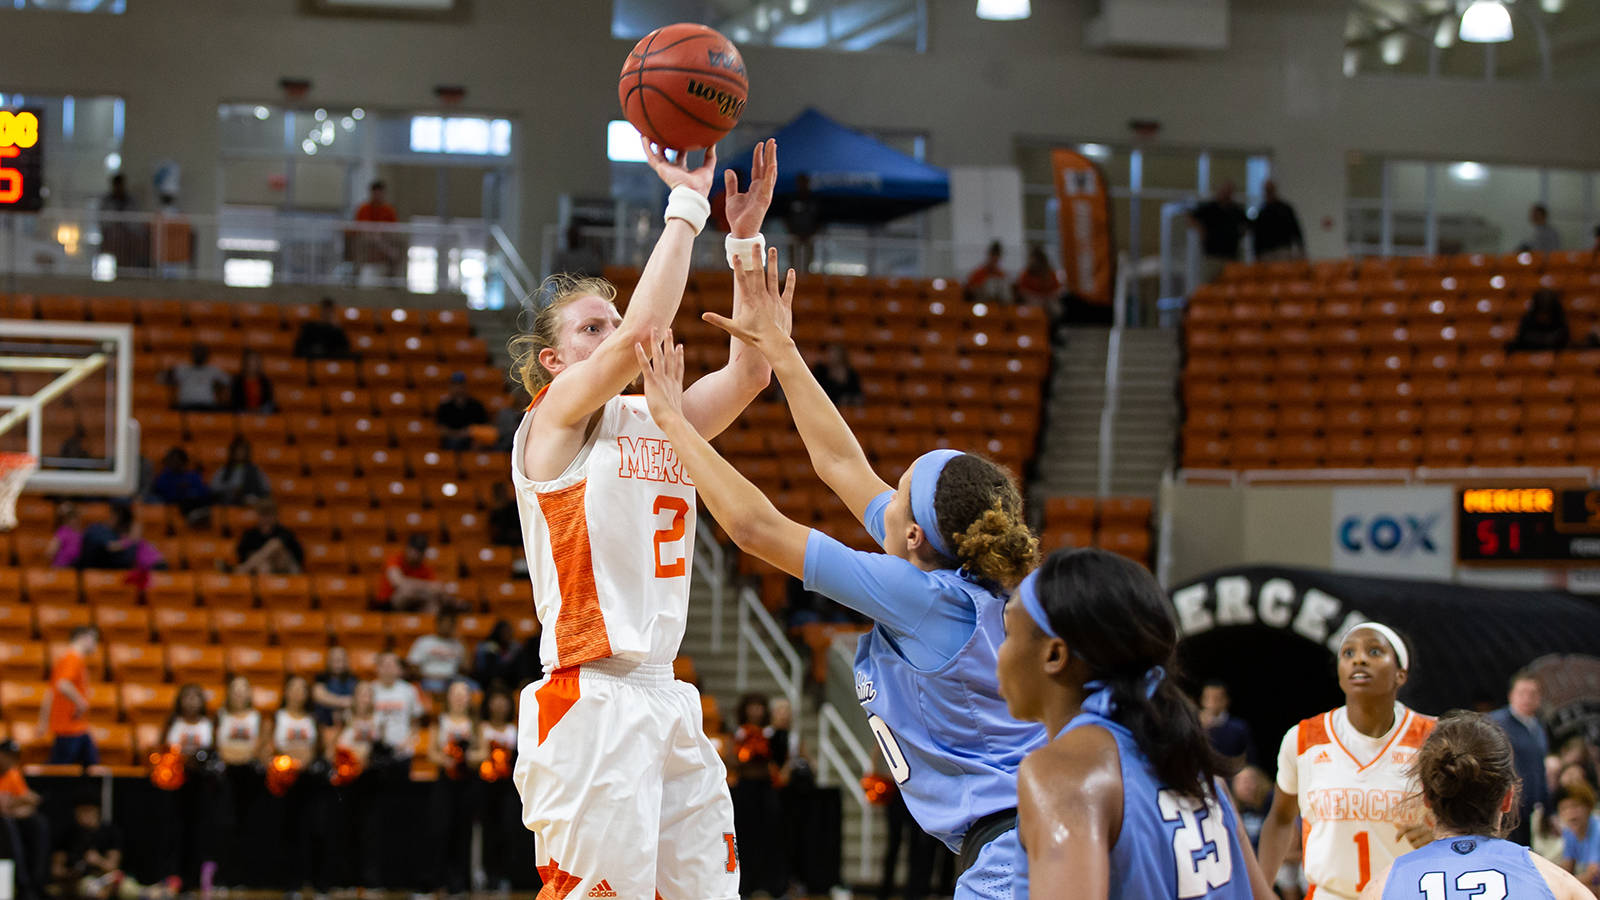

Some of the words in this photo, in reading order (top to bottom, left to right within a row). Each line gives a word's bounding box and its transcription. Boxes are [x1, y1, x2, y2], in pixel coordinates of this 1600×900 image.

[653, 495, 689, 578] 2
[1338, 515, 1438, 553] COX
[1173, 575, 1369, 655] ERCE
[1157, 783, 1232, 899] 23
[1353, 831, 1371, 893] 1
[588, 889, 617, 898] adidas
